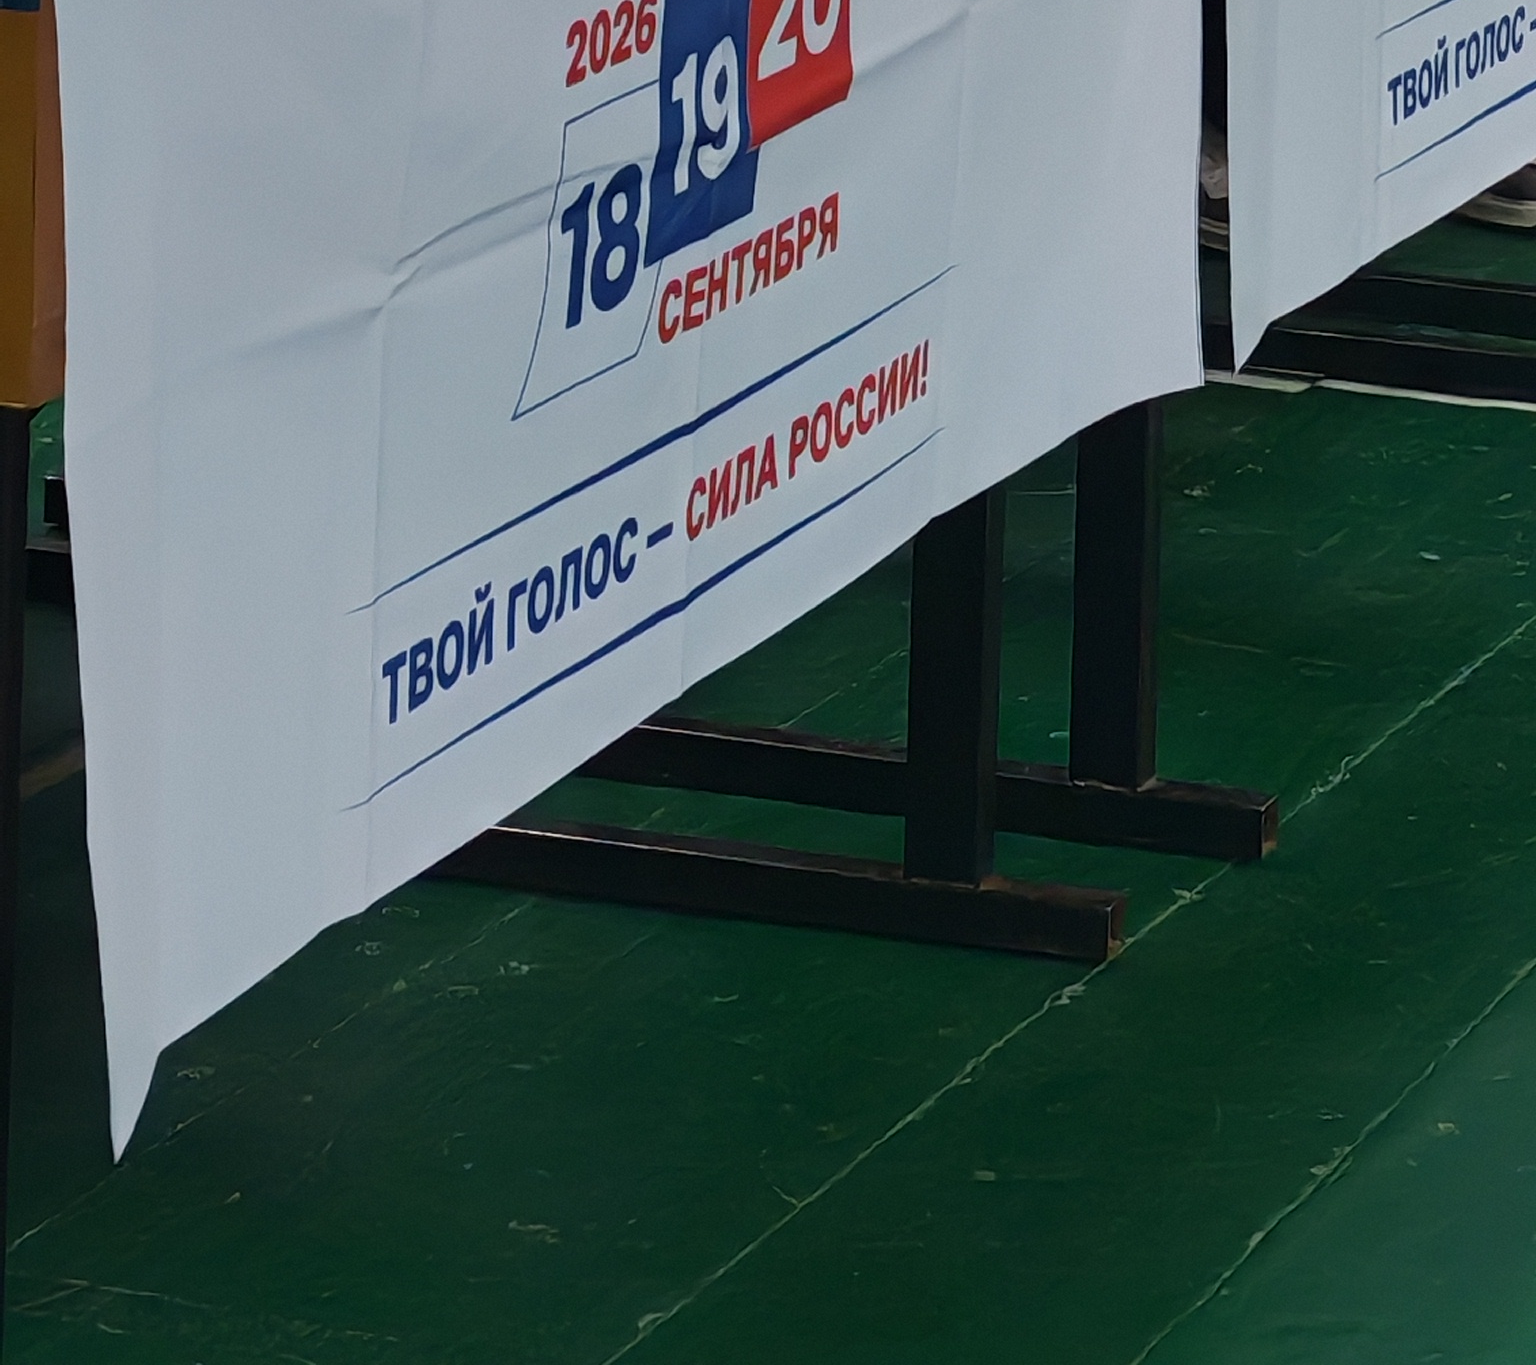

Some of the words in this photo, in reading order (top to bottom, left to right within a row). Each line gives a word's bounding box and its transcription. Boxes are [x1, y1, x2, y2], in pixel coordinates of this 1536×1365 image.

[671, 35, 741, 196] 19
[1387, 35, 1450, 125] ТВОЙ
[1455, 6, 1525, 89] ГОЛОС
[561, 164, 644, 329] 18
[658, 192, 840, 344] СЕНТЯБРЯ
[382, 582, 494, 724] ТВОЙ
[507, 517, 637, 652] ГОЛОС
[685, 434, 778, 541] СИЛА
[787, 339, 930, 480] РОССИИ!
